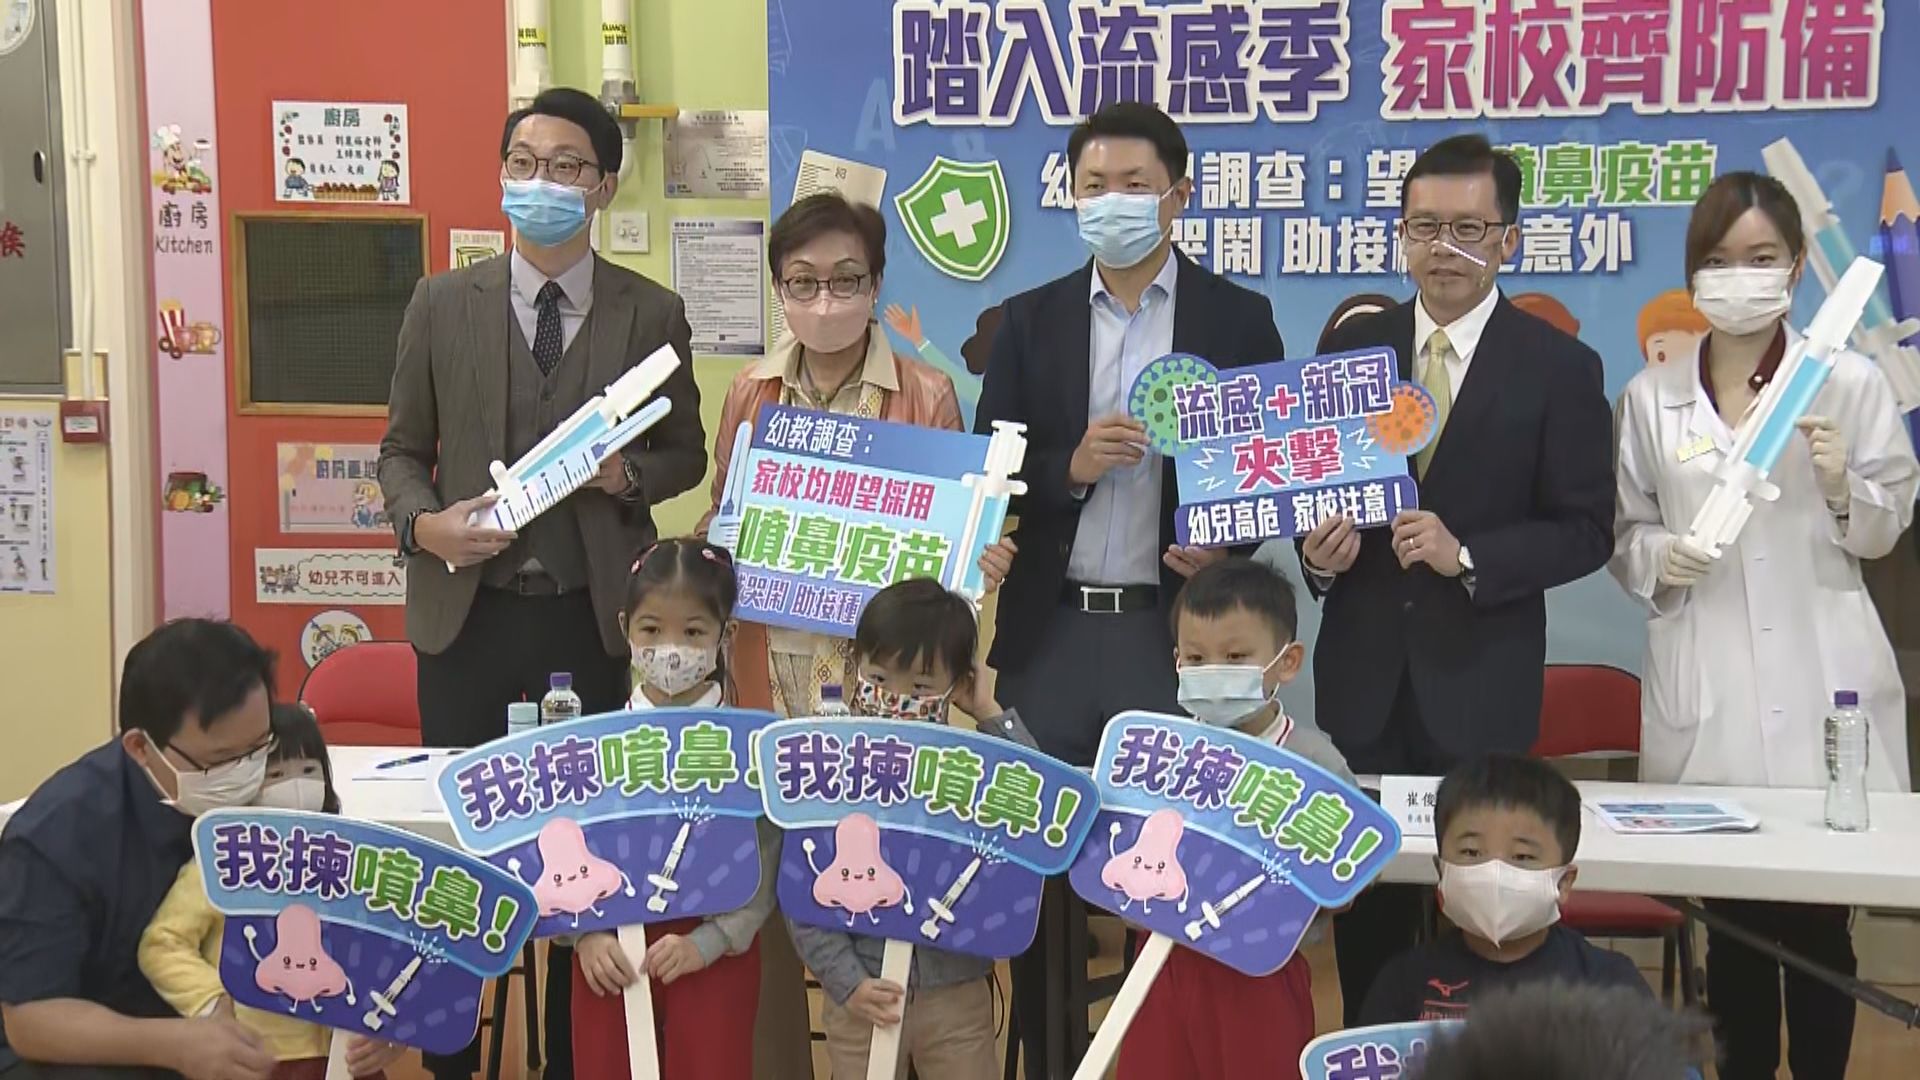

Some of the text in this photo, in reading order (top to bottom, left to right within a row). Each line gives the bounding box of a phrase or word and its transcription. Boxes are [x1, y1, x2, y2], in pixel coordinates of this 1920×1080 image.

[897, 0, 1876, 120] 踏入流感季 家校齊防備
[324, 108, 360, 127] 廚房
[155, 236, 213, 254] Kitchen
[159, 202, 208, 229] 廚房
[1499, 214, 1633, 273] 意外
[764, 410, 873, 458] 幼教調查：
[1232, 424, 1344, 493] 夾擊
[752, 459, 935, 521] 家校均期望採用
[736, 504, 950, 586] 噴鼻疫苗
[1188, 501, 1280, 544] 幼兒高危
[308, 570, 401, 586] 幼兒不可進入
[791, 582, 862, 625] 助接種
[776, 733, 1080, 848] 我揀噴鼻！
[1110, 726, 1382, 881] 我揀噴鼻！
[214, 824, 520, 952] 我揀噴鼻！
